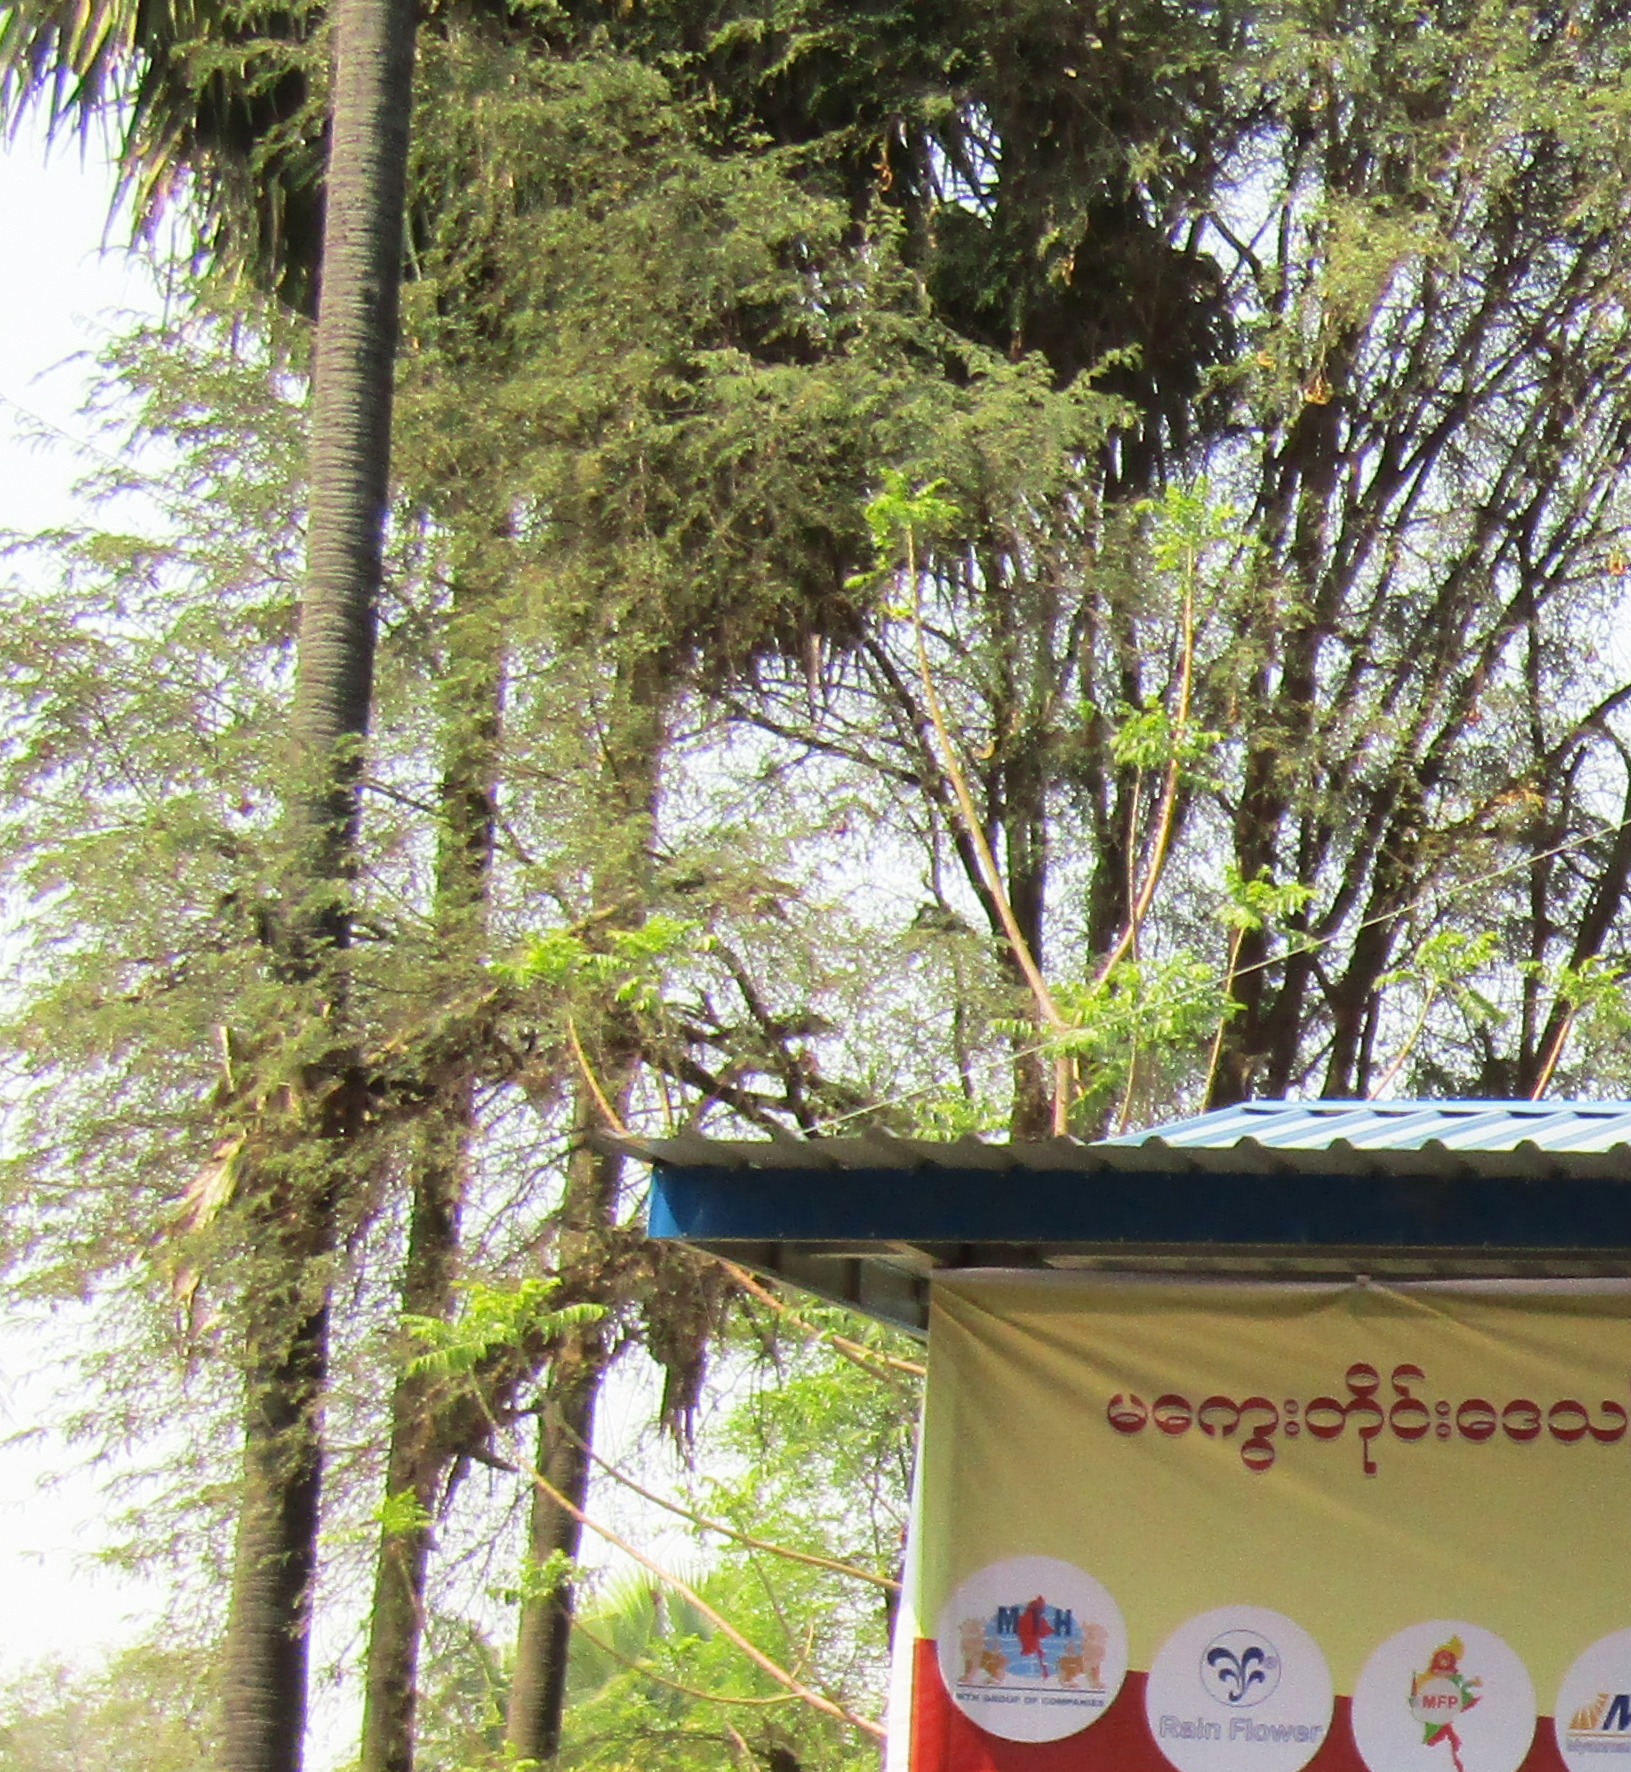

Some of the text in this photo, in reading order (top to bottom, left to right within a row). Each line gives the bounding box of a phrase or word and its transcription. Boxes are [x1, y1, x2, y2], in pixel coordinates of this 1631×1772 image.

[1422, 1695, 1458, 1708] MFP
[1159, 1715, 1322, 1743] Rain Flower
